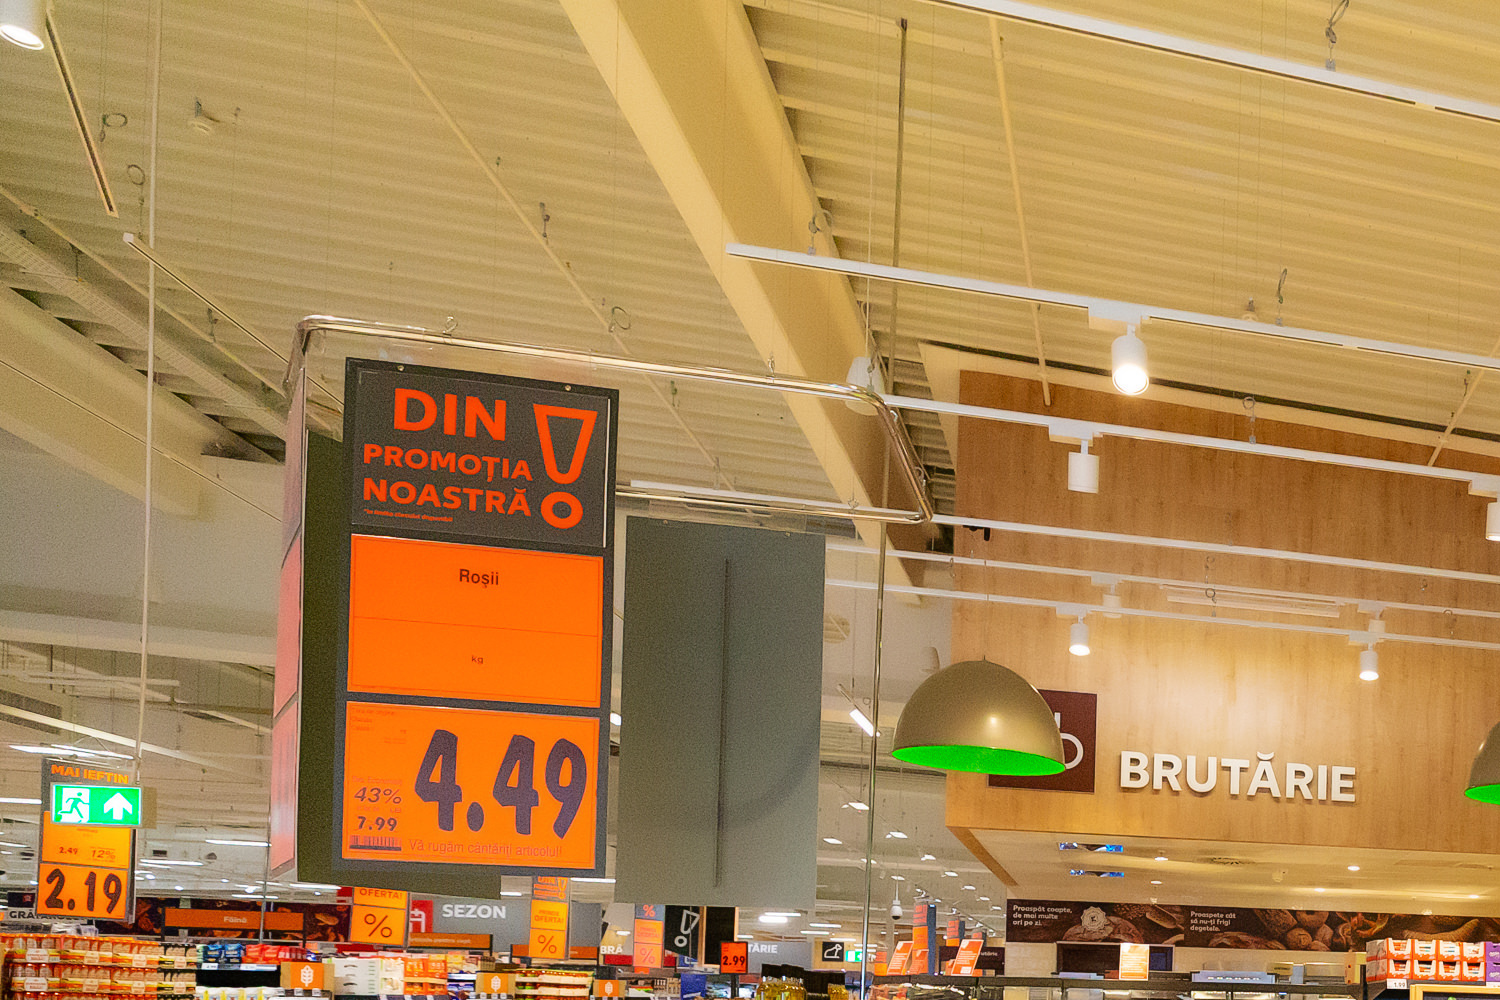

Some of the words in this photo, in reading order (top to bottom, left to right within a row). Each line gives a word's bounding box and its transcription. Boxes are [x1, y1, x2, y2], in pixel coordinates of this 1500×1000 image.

[394, 387, 507, 441] DIN
[363, 443, 533, 482] PROMOȚIA
[363, 477, 531, 517] NOASTRĂ
[471, 654, 484, 665] kg
[51, 764, 80, 778] MAI
[83, 768, 129, 784] IEFTIN
[414, 728, 587, 839] 4.49
[1120, 750, 1356, 803] BRUTĂRIE
[353, 786, 402, 805] 43%
[357, 815, 398, 831] 7.99
[409, 839, 425, 851] Vă
[428, 841, 464, 854] rugăm
[45, 868, 122, 914] 2.19
[441, 903, 507, 919] SEZON
[364, 913, 393, 938] %
[537, 934, 557, 954] %
[748, 942, 778, 954] TĂRIE
[722, 955, 745, 966] 2.99
